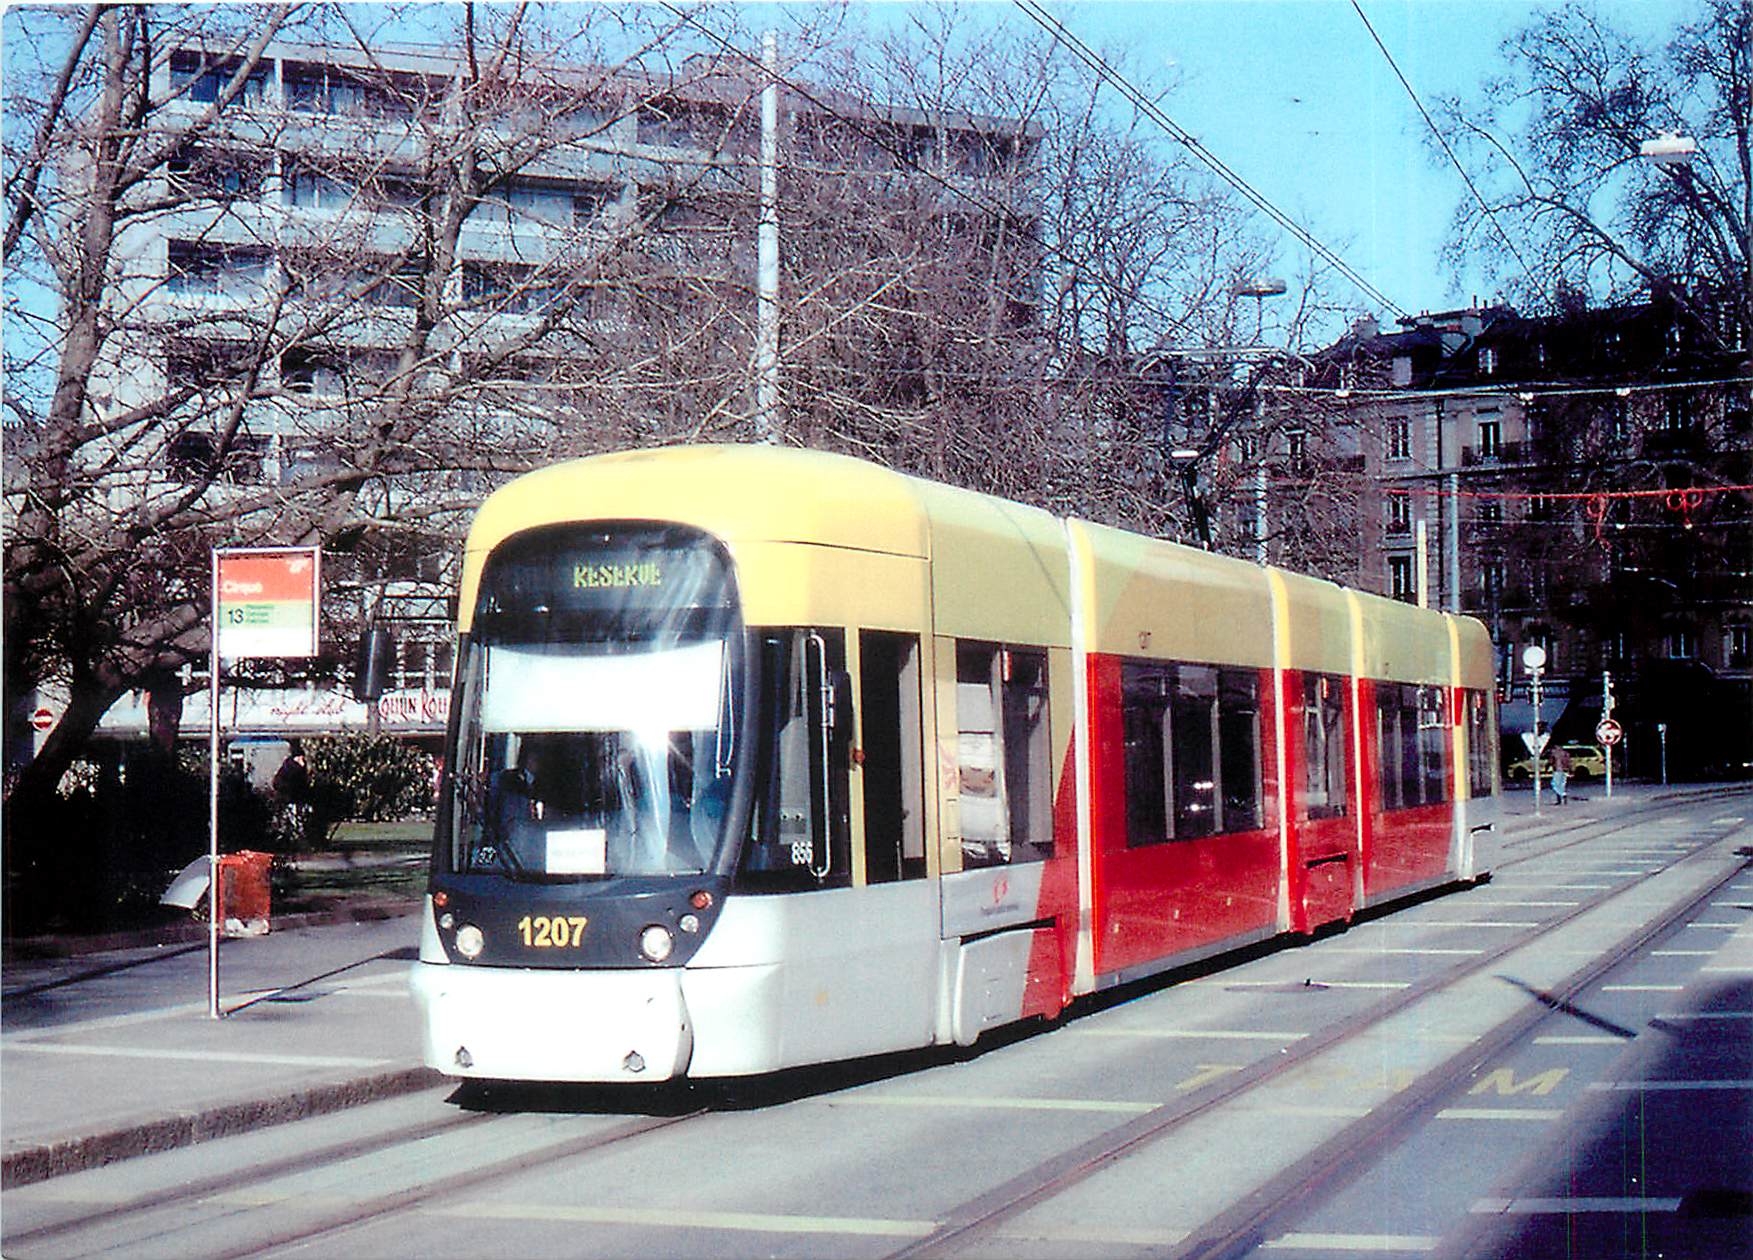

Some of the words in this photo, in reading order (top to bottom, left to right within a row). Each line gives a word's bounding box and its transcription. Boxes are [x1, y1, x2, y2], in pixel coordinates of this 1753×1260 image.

[228, 608, 244, 624] 13
[379, 697, 417, 721] OULIN
[518, 916, 588, 947] 1207
